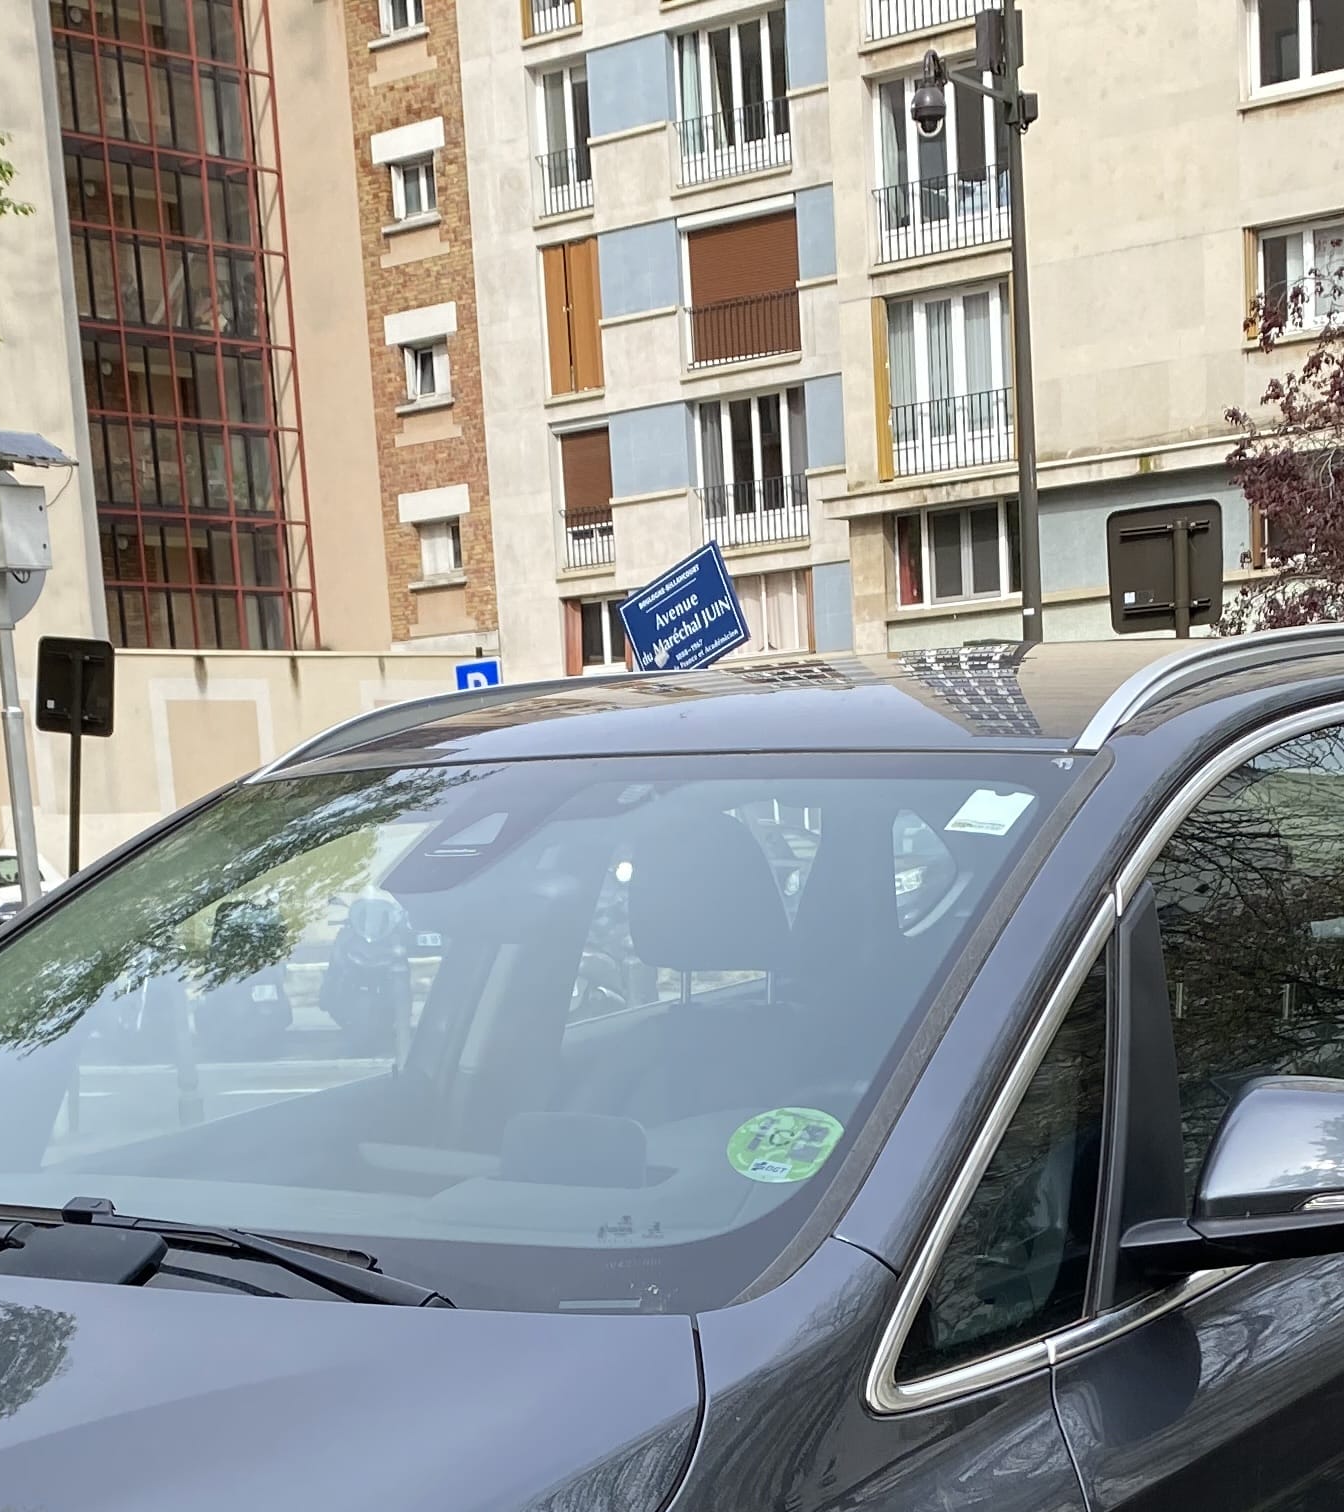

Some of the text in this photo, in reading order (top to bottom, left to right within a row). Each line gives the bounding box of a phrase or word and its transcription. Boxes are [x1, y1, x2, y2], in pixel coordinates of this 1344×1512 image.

[642, 595, 732, 666] du Maréchal JUIN
[656, 593, 699, 630] Avenue
